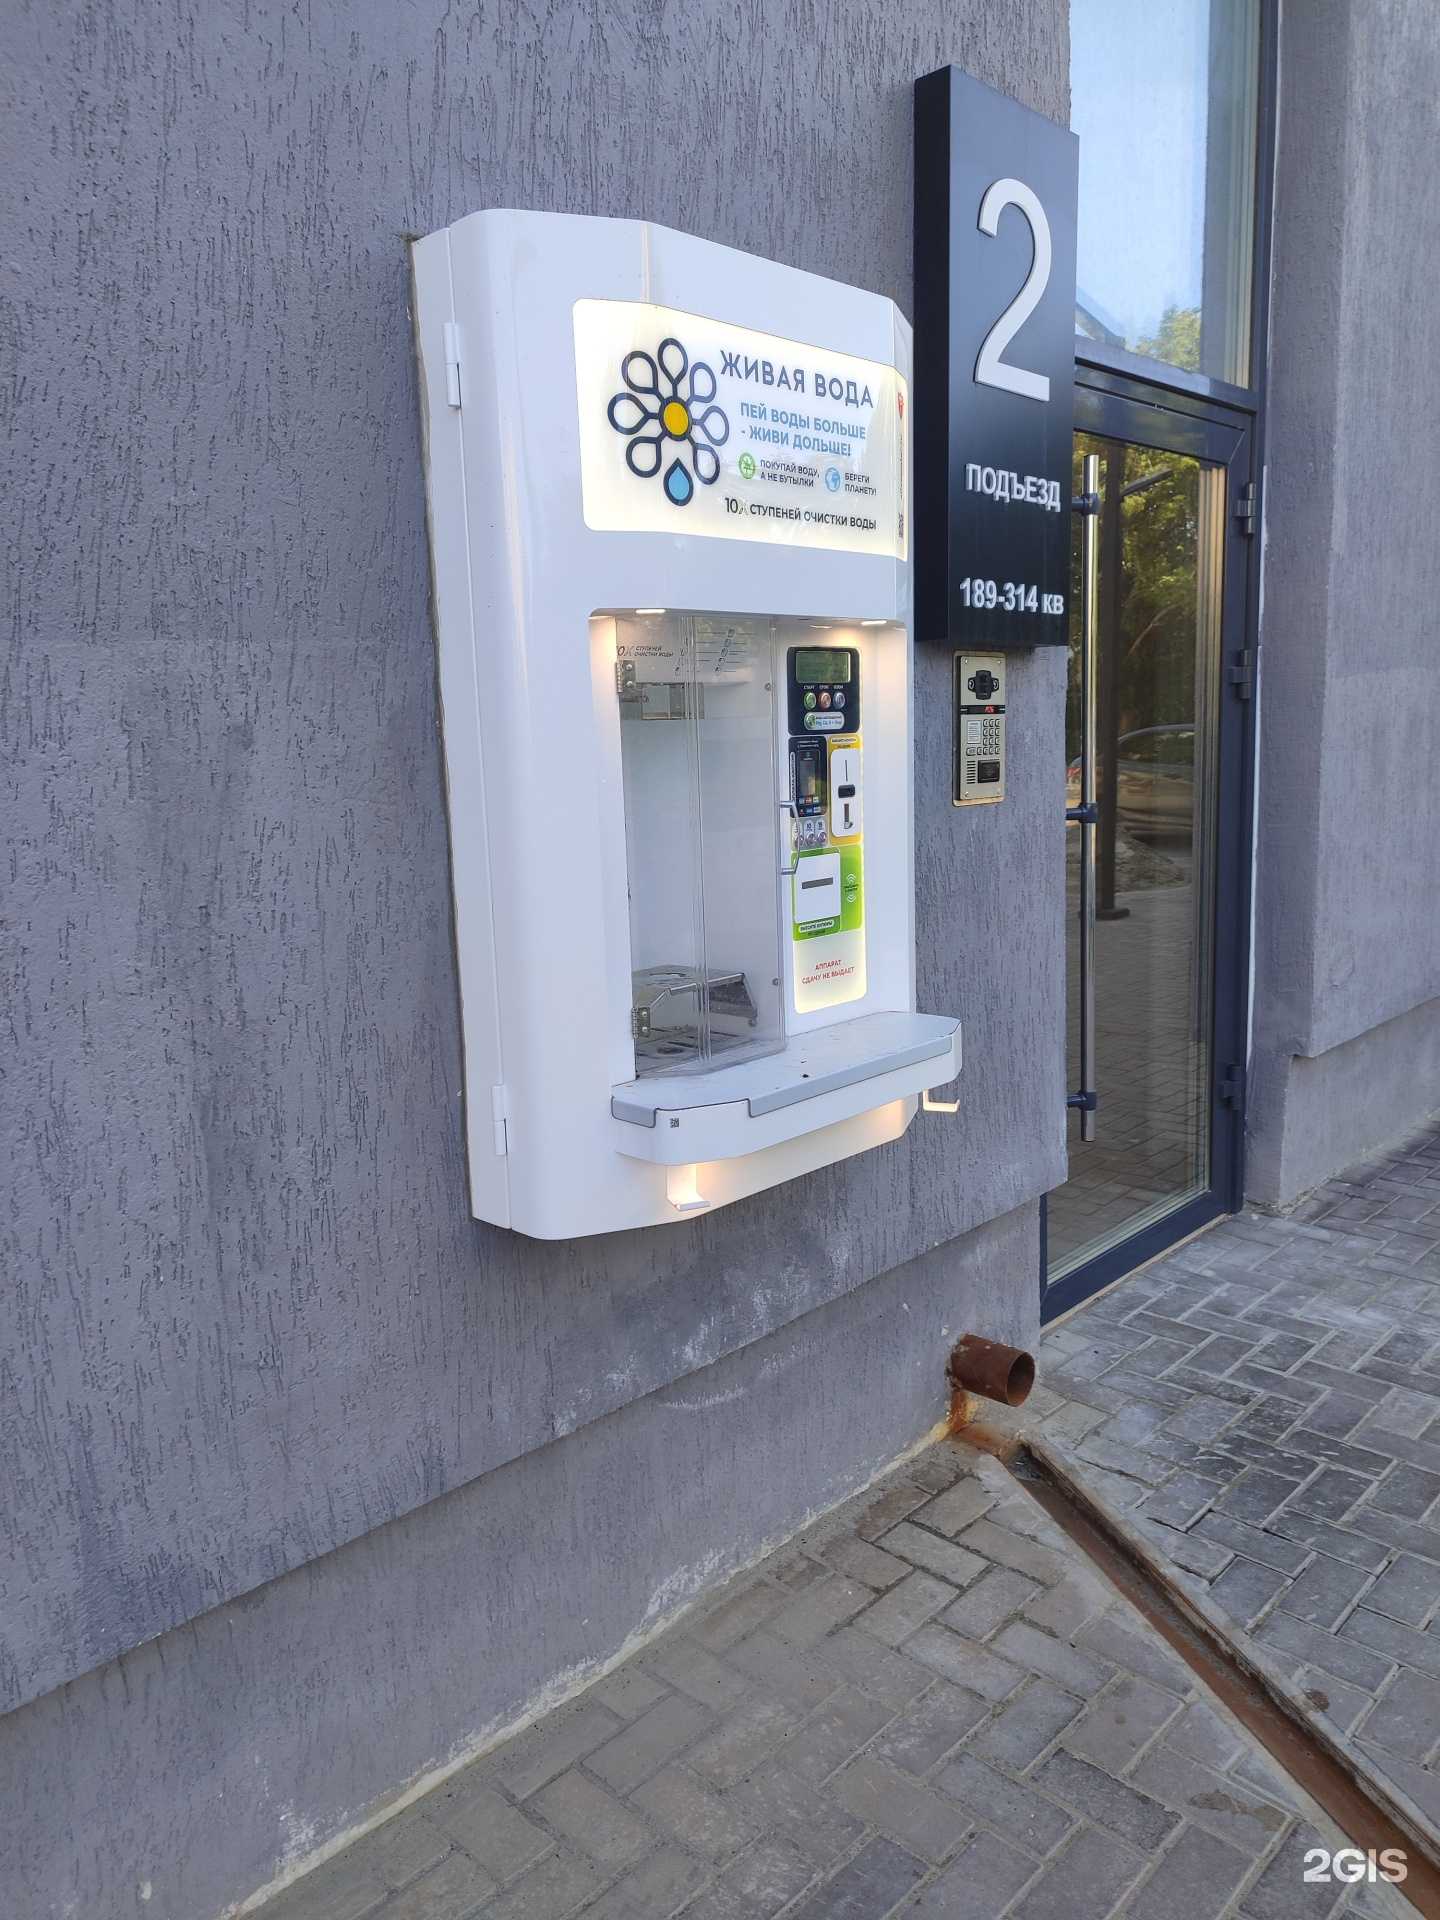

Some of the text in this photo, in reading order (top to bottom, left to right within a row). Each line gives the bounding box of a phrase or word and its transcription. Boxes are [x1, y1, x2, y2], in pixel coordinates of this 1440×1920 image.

[974, 178, 1052, 401] 2
[720, 350, 874, 408] ЖИВАЯ ВОДА
[740, 402, 866, 440] ПЕЙ ВОДЫ БОЛЬШЕ
[749, 425, 789, 446] ЖИВИ
[793, 434, 851, 457] ДОЛЬШЕ!
[760, 459, 820, 479] ПОКУПАЙ ВОДУ,
[760, 472, 814, 488] А НЕ БУТЫЛКИ
[845, 472, 870, 483] БЕРЕГИ
[845, 483, 877, 496] ПЛАНЕТУ!
[965, 463, 1061, 512] ПОДЪЕЗД
[750, 504, 801, 521] СТУПЕНЕЙ
[804, 511, 847, 526] ОЧИСТКИ
[850, 517, 877, 530] ВОДЫ
[960, 577, 1038, 613] 189-314
[801, 973, 822, 985] СДАЧУ
[822, 970, 831, 980] НЕ
[815, 959, 842, 971] АППАРАТ
